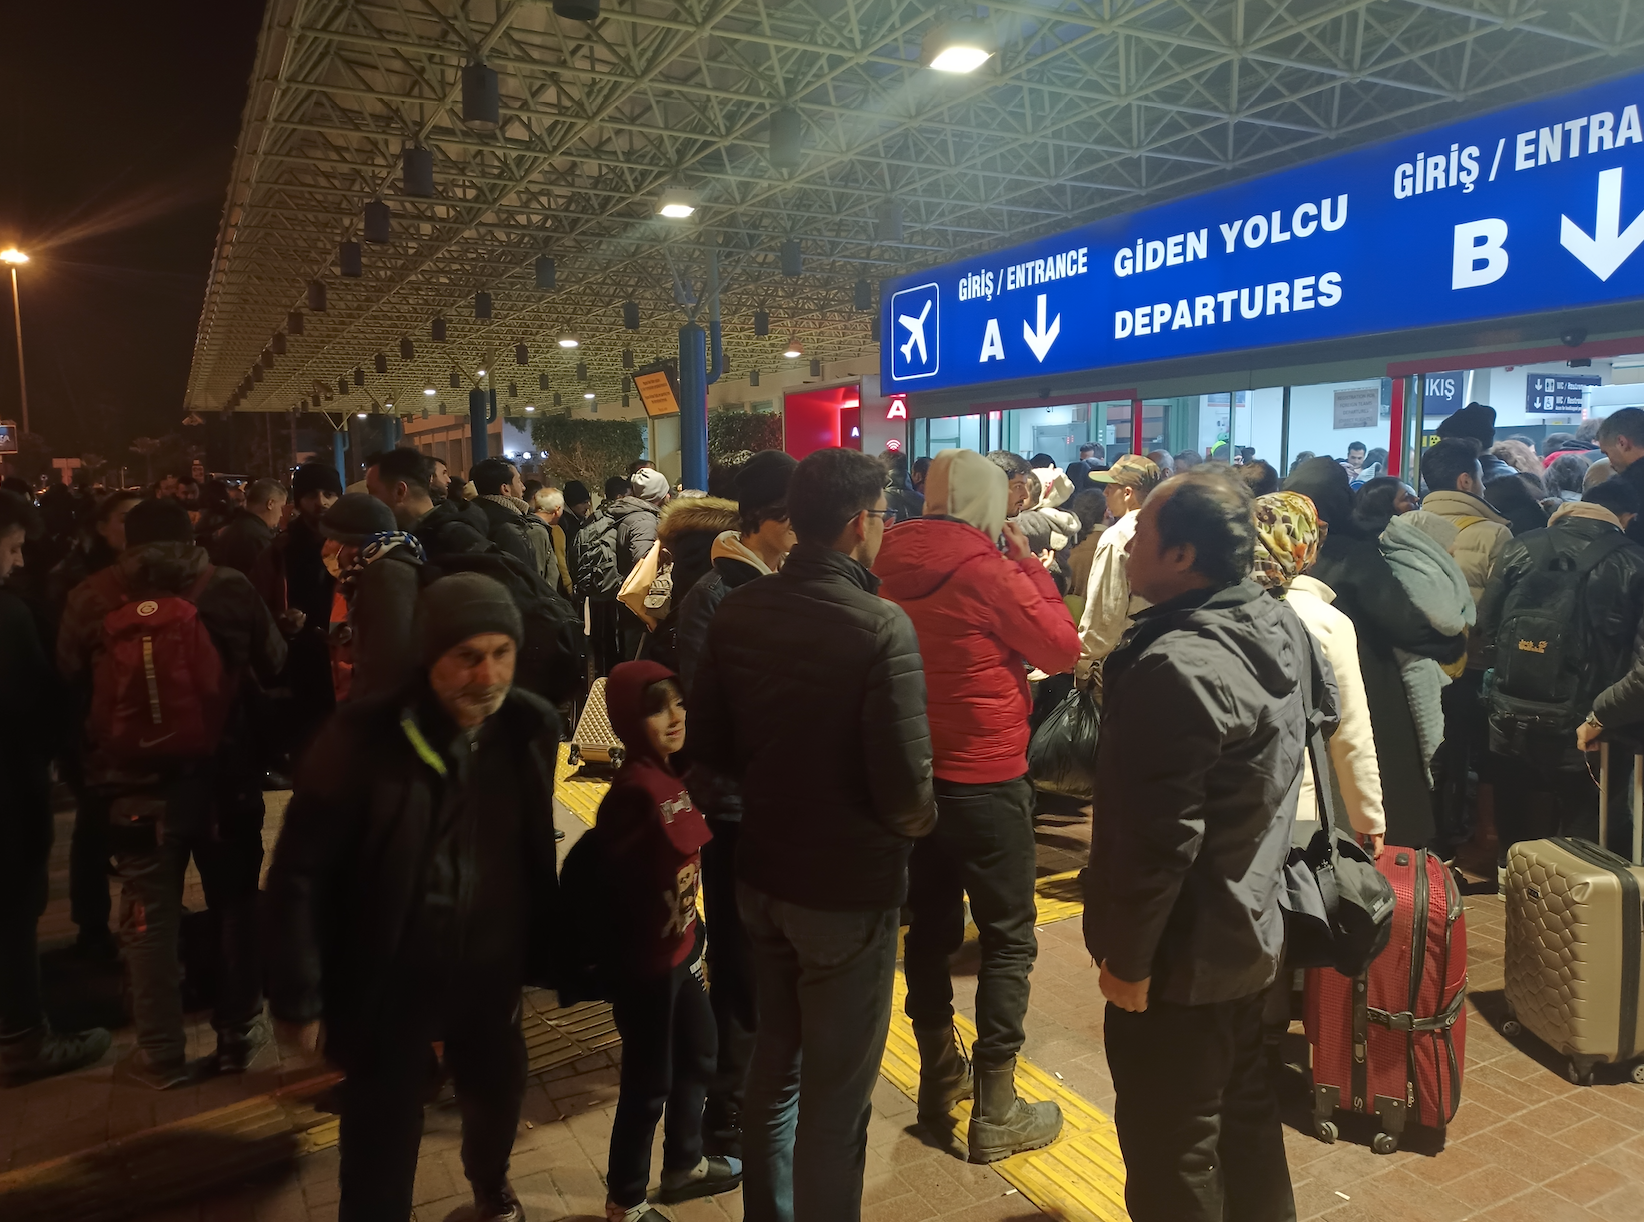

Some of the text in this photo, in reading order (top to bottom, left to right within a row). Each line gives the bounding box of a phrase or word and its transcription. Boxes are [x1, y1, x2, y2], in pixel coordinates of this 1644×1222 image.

[1393, 104, 1643, 199] GİRİŞ / ENTRA
[1114, 194, 1348, 278] GİDEN YOLCU
[1452, 218, 1509, 290] B
[958, 269, 994, 301] GİRİŞ
[1006, 247, 1088, 290] ENTRANCE
[1114, 272, 1342, 339] DEPARTURES
[979, 318, 1005, 363] A
[852, 427, 859, 436] A
[886, 400, 906, 419] A
